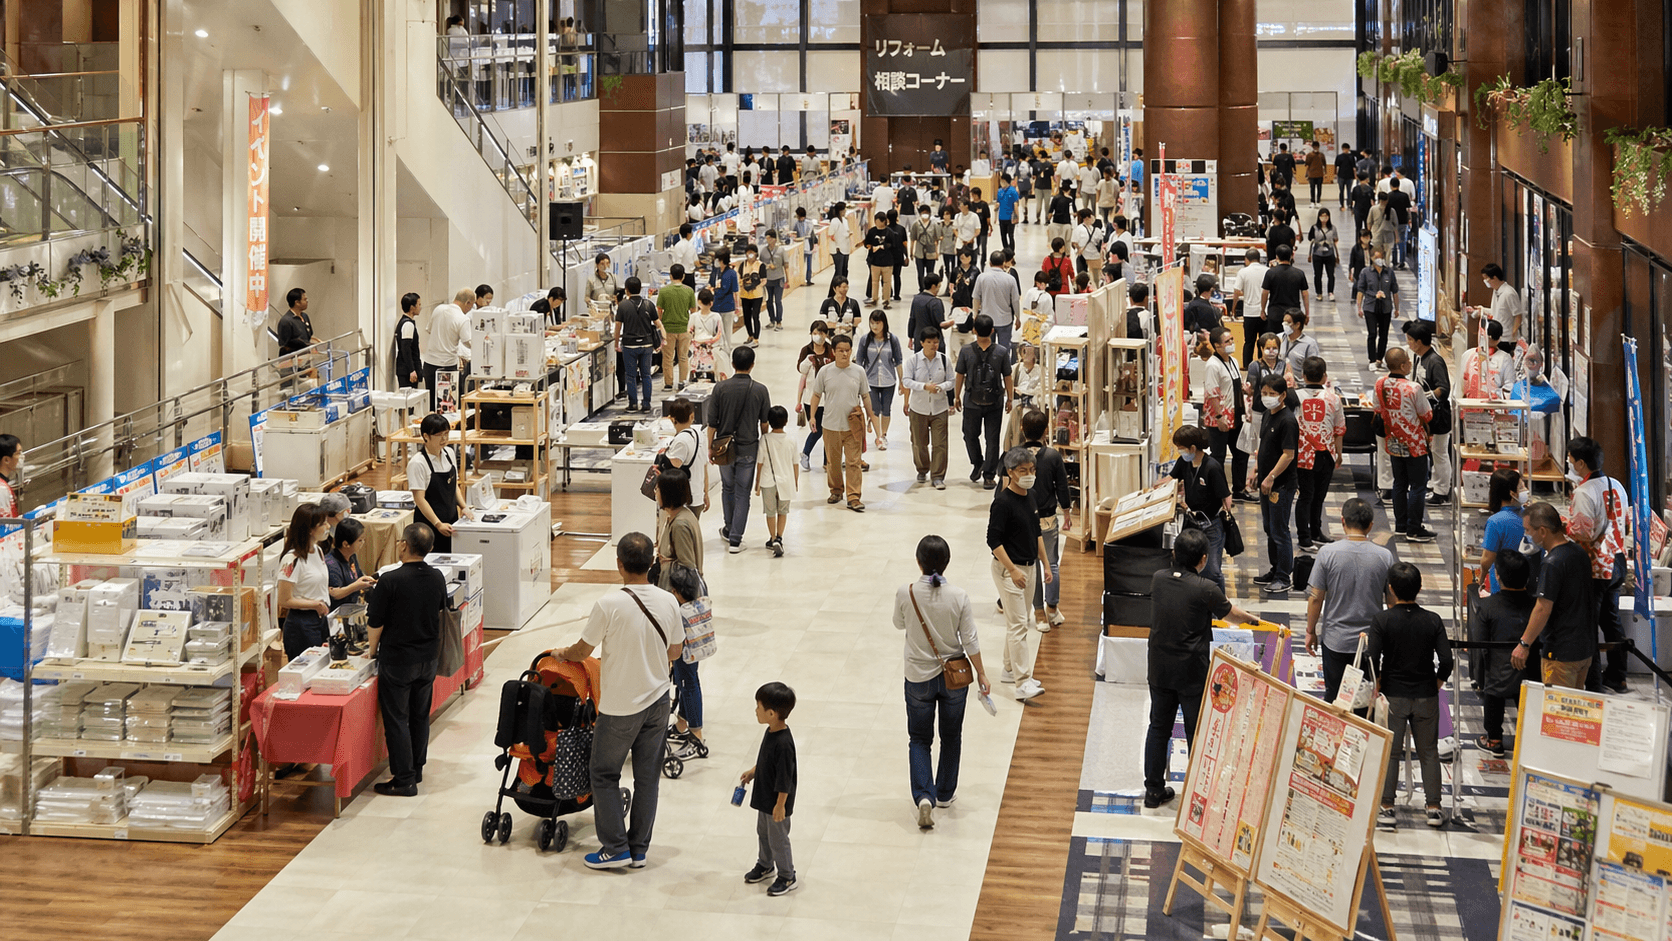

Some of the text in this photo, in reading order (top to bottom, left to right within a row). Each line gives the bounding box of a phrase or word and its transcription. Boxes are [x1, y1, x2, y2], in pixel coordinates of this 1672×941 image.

[875, 39, 946, 57] リフォーム
[874, 71, 965, 92] 相談コーナー
